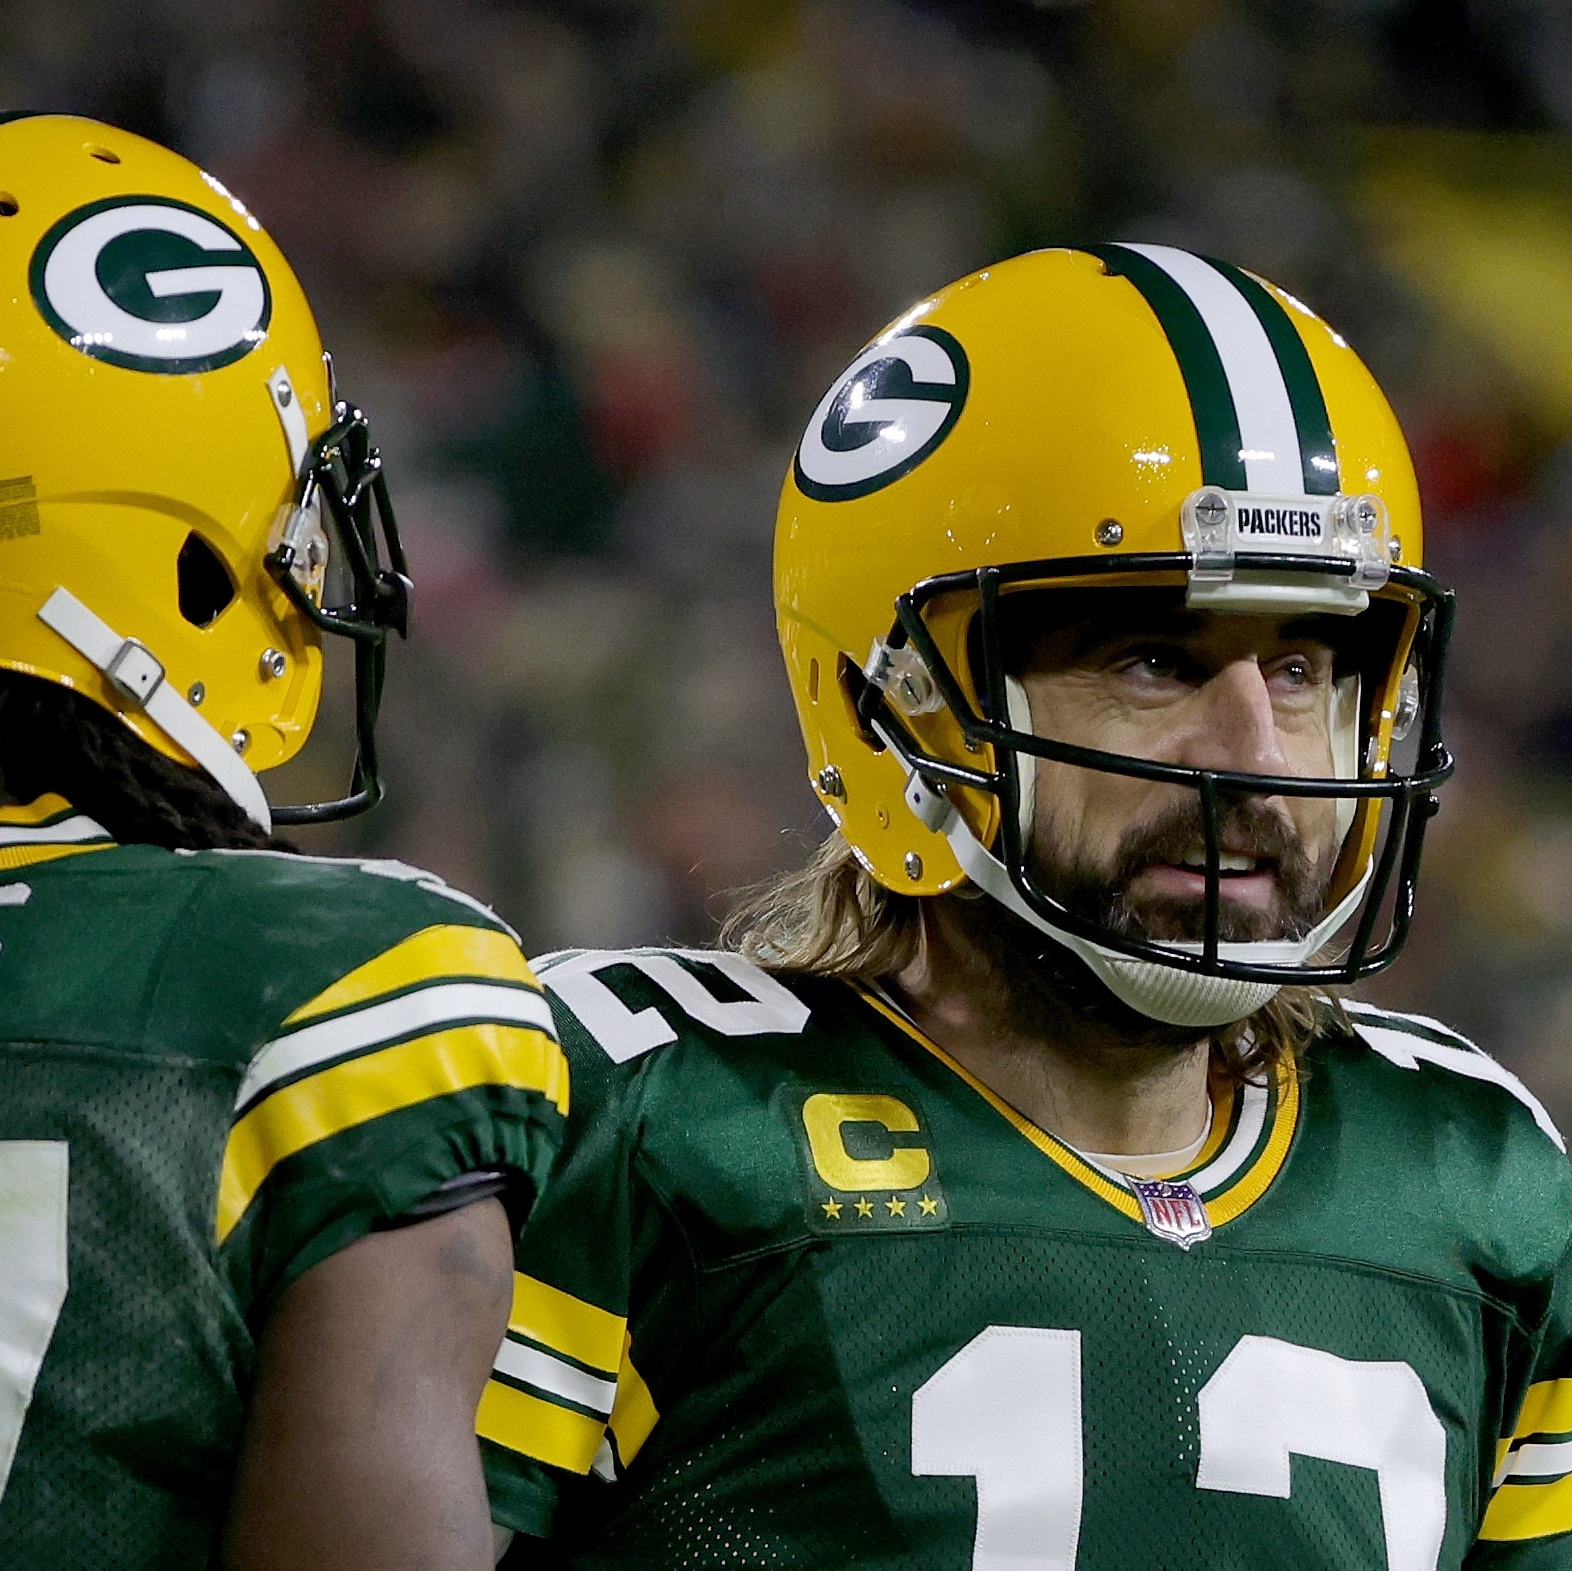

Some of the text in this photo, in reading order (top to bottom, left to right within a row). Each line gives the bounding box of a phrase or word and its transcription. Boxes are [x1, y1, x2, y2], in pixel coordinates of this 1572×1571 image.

[45, 204, 266, 360] G
[797, 330, 957, 487] G
[1237, 507, 1322, 538] PACKERS
[802, 1092, 931, 1192] C
[1149, 1198, 1202, 1232] NFL
